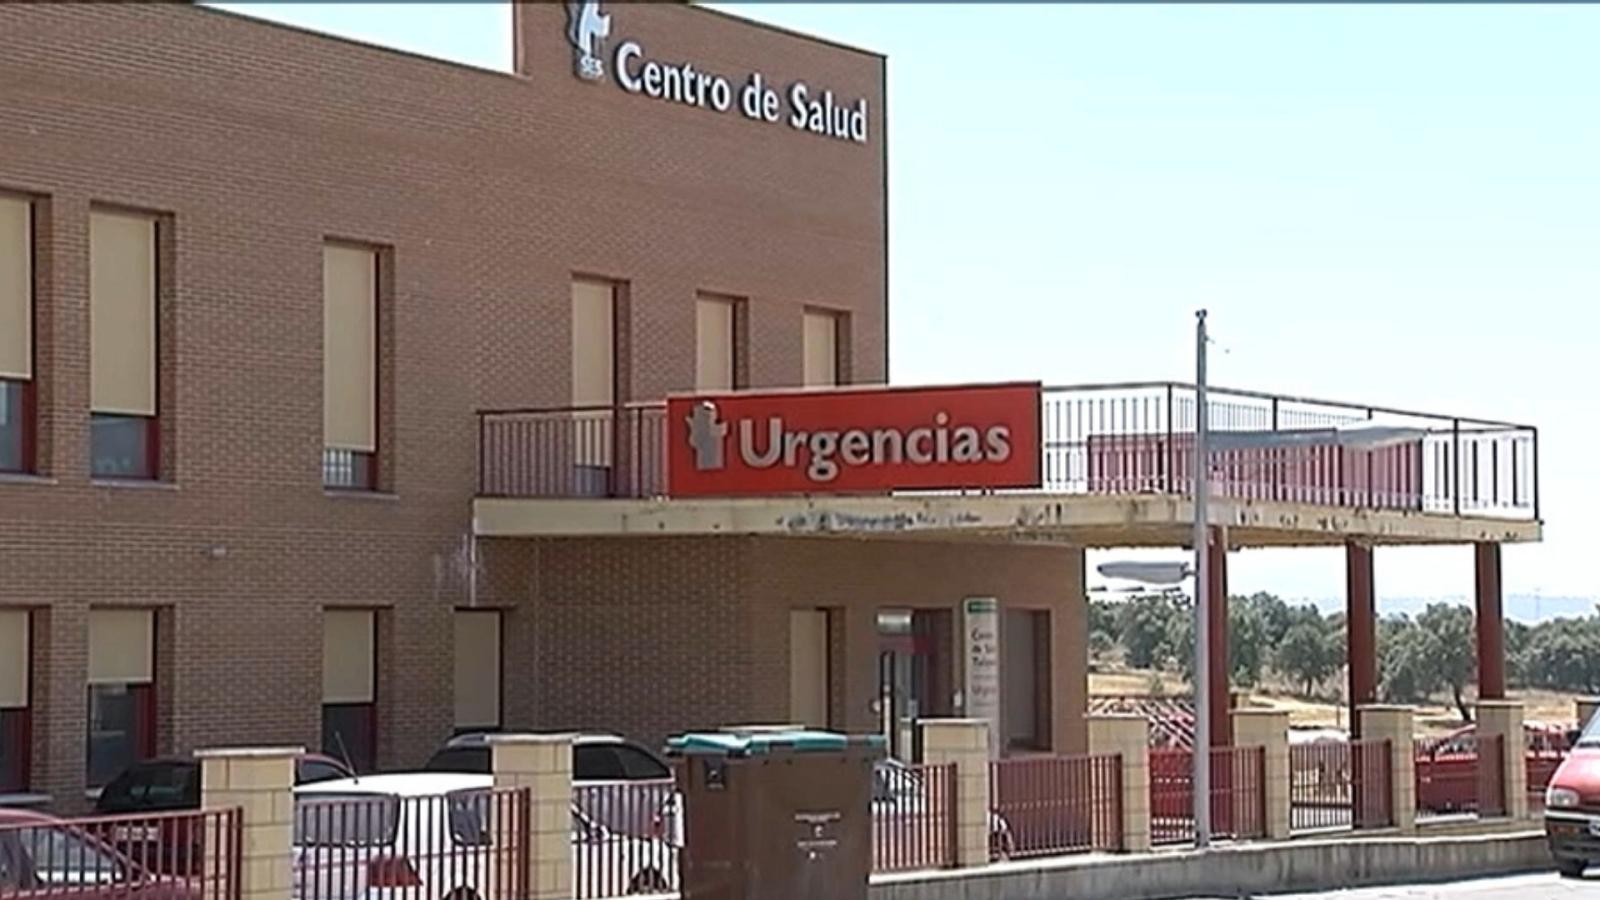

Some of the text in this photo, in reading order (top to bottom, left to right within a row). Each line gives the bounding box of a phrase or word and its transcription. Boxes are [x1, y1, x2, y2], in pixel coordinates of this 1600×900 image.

[615, 41, 867, 143] Centro de Salud
[739, 411, 1010, 482] Urgencias
